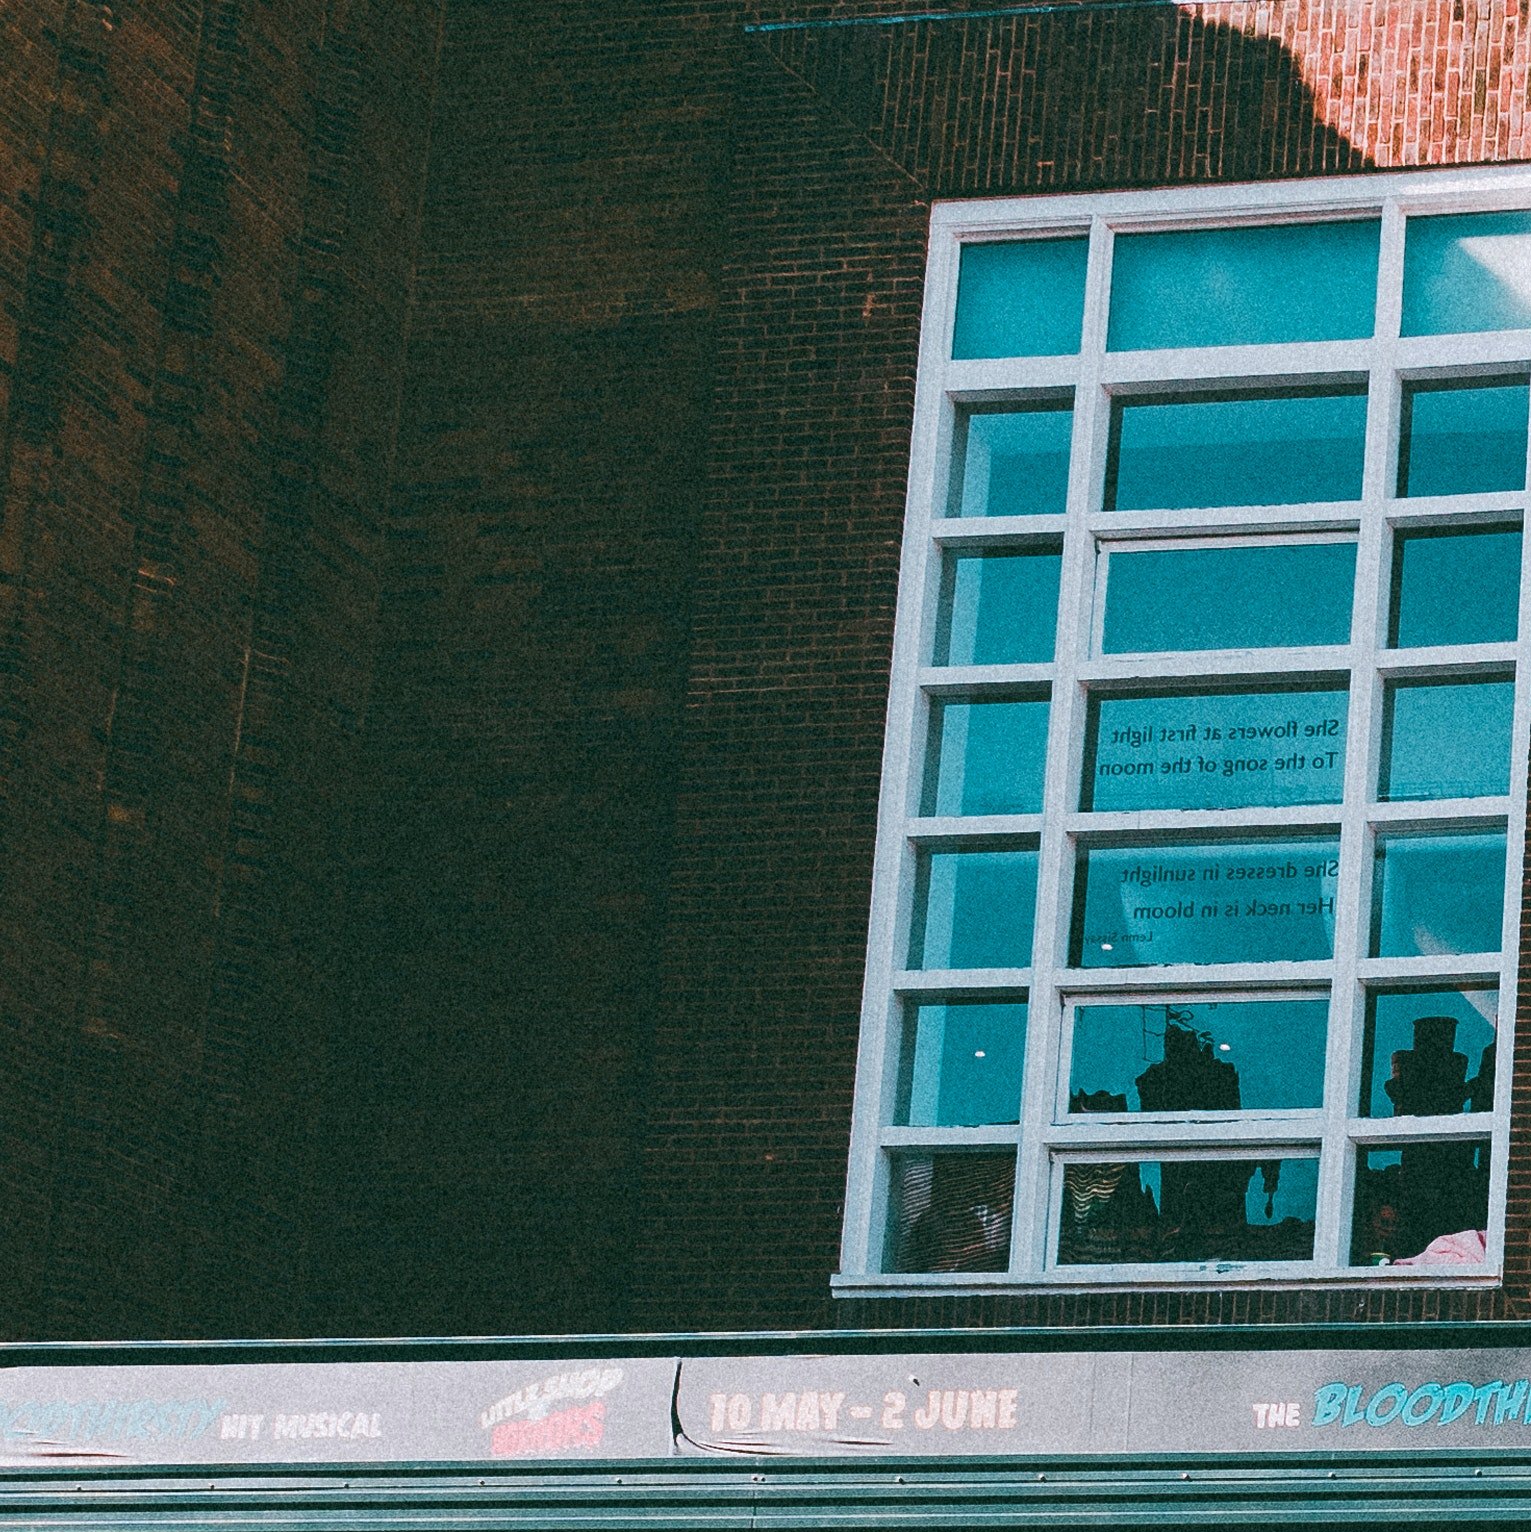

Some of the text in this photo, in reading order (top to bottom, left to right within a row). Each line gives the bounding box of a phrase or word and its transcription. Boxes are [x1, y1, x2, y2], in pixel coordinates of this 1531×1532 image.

[709, 1391, 752, 1433] 10
[759, 1389, 845, 1432] MAY
[881, 1390, 907, 1431] 2
[913, 1386, 1019, 1430] JUNE
[1252, 1400, 1300, 1429] THE
[219, 1413, 265, 1440] HIT
[272, 1412, 382, 1439] MUSICAL
